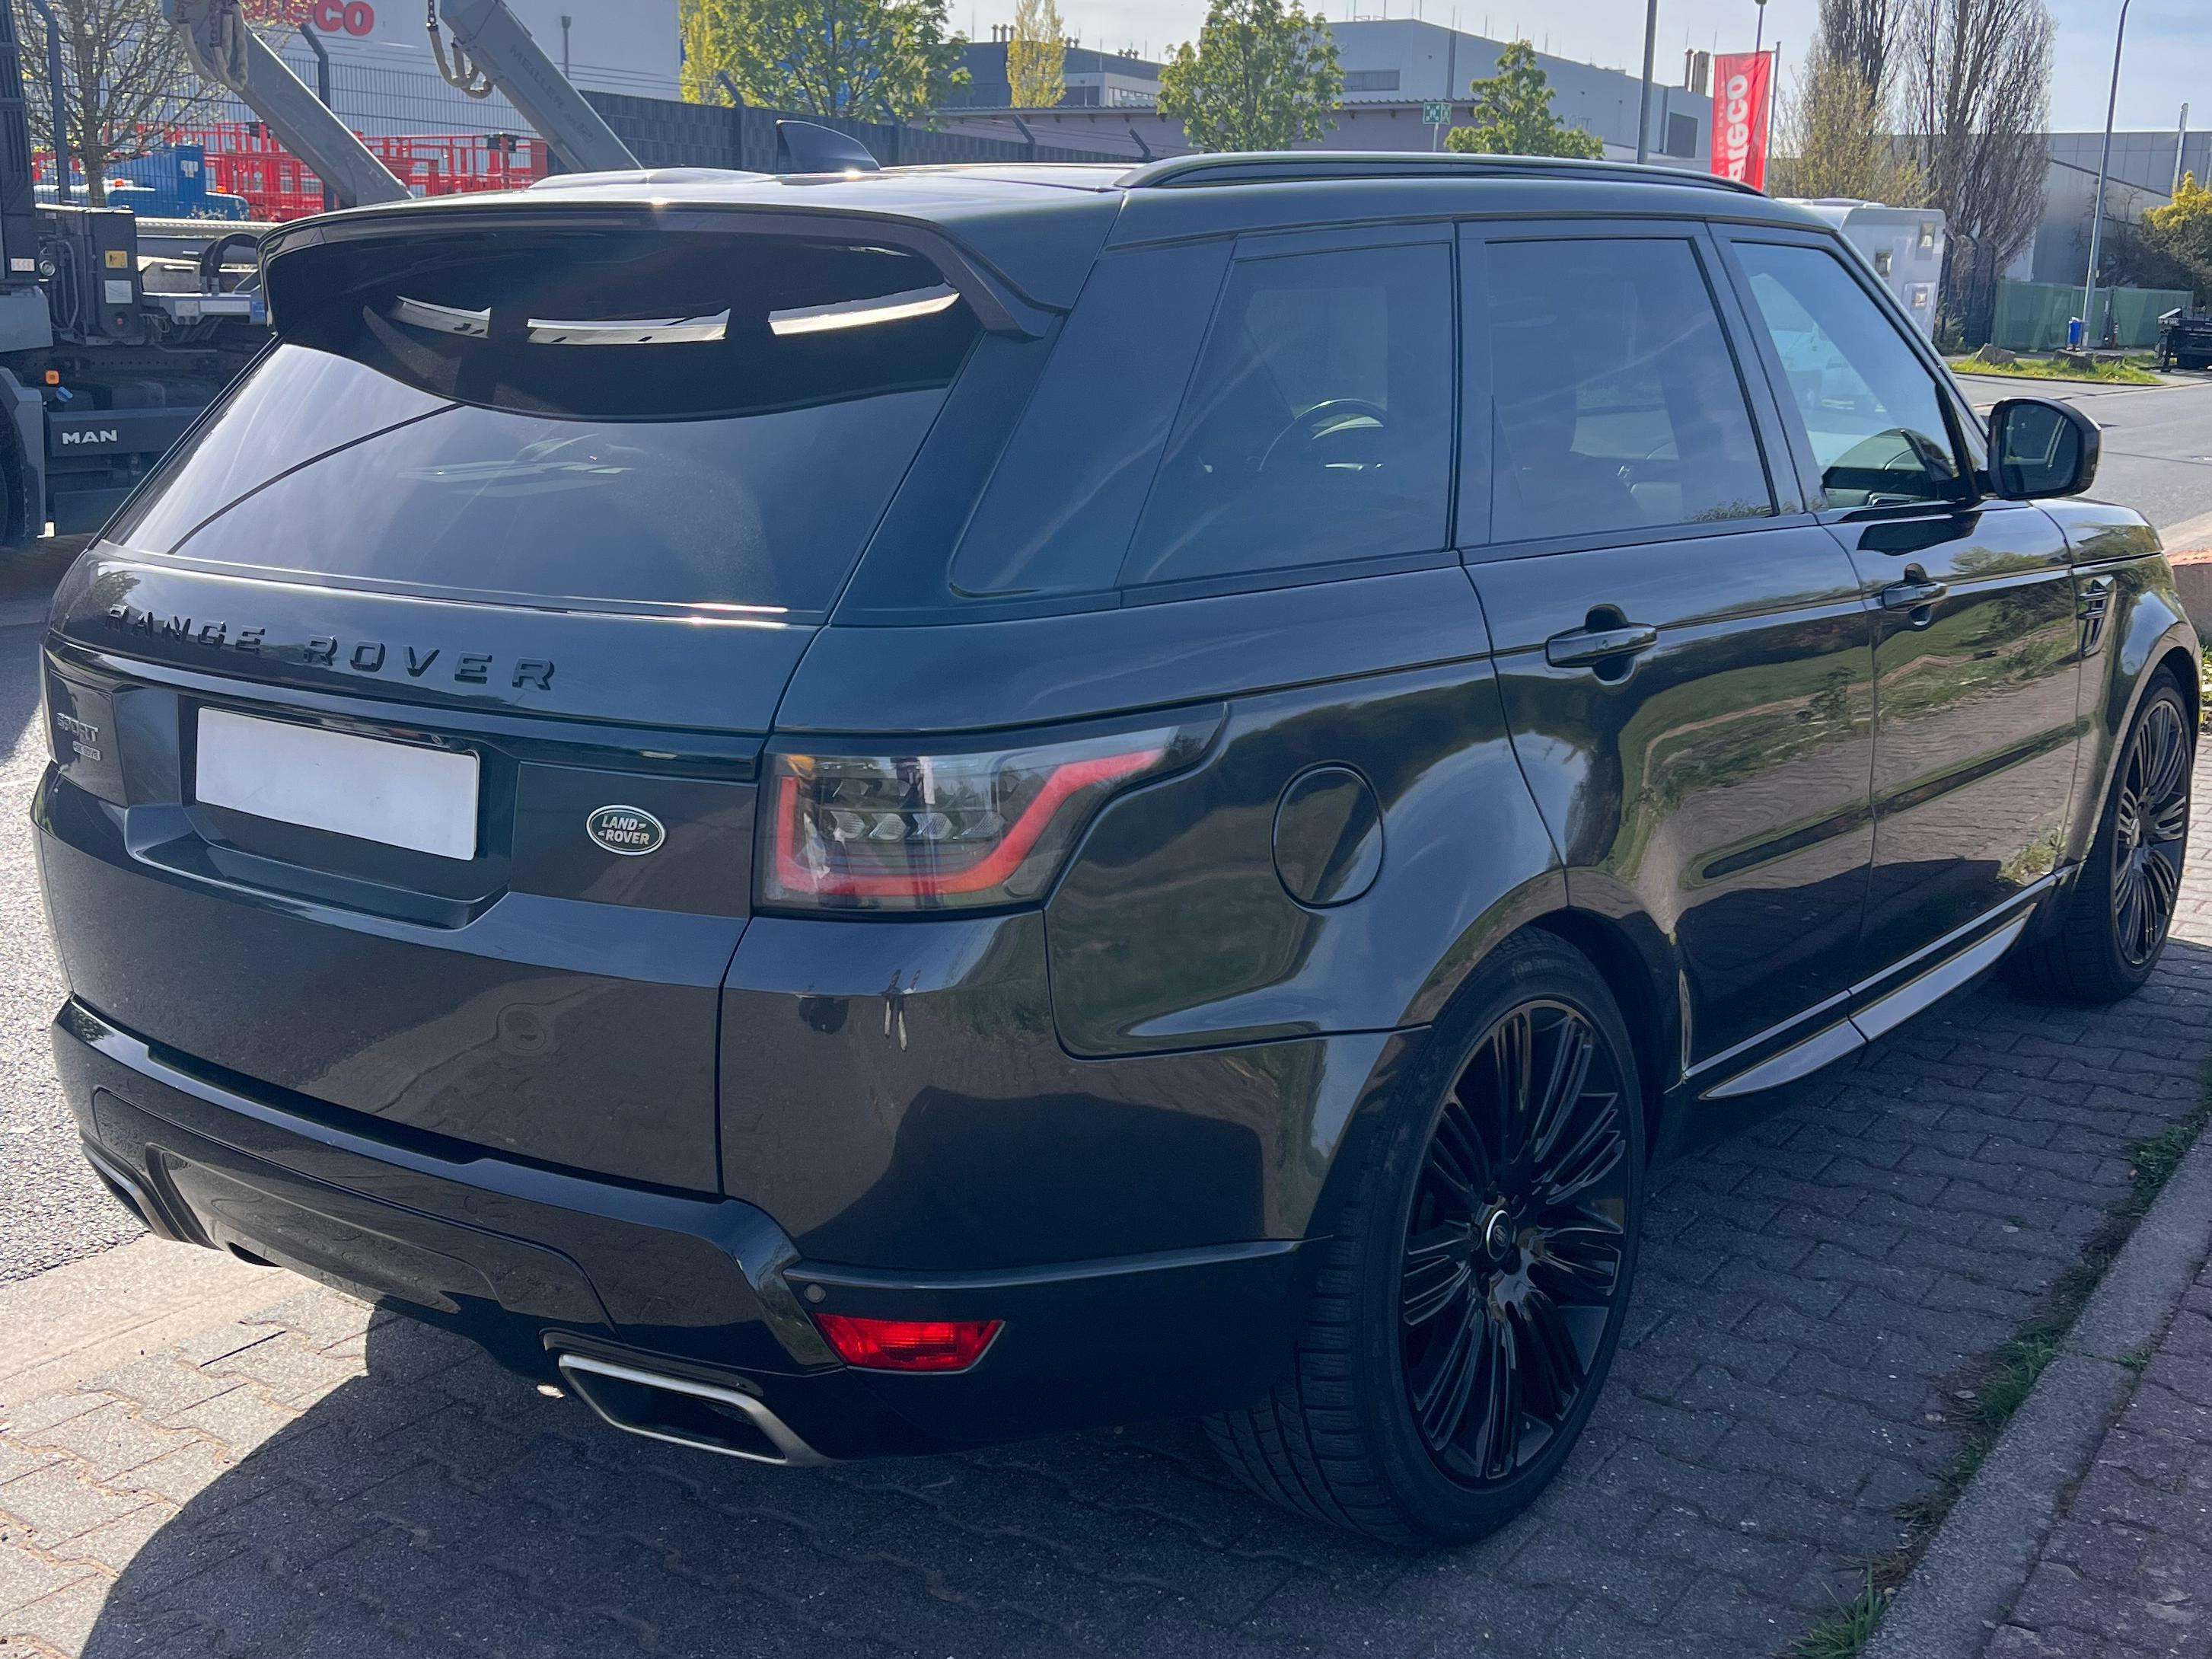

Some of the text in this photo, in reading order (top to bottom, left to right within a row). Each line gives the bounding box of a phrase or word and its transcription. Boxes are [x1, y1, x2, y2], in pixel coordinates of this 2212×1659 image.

[62, 429, 118, 445] MAN
[105, 603, 555, 691] RANGE ROVER
[601, 815, 638, 831] LAND
[605, 828, 650, 845] ROVER
